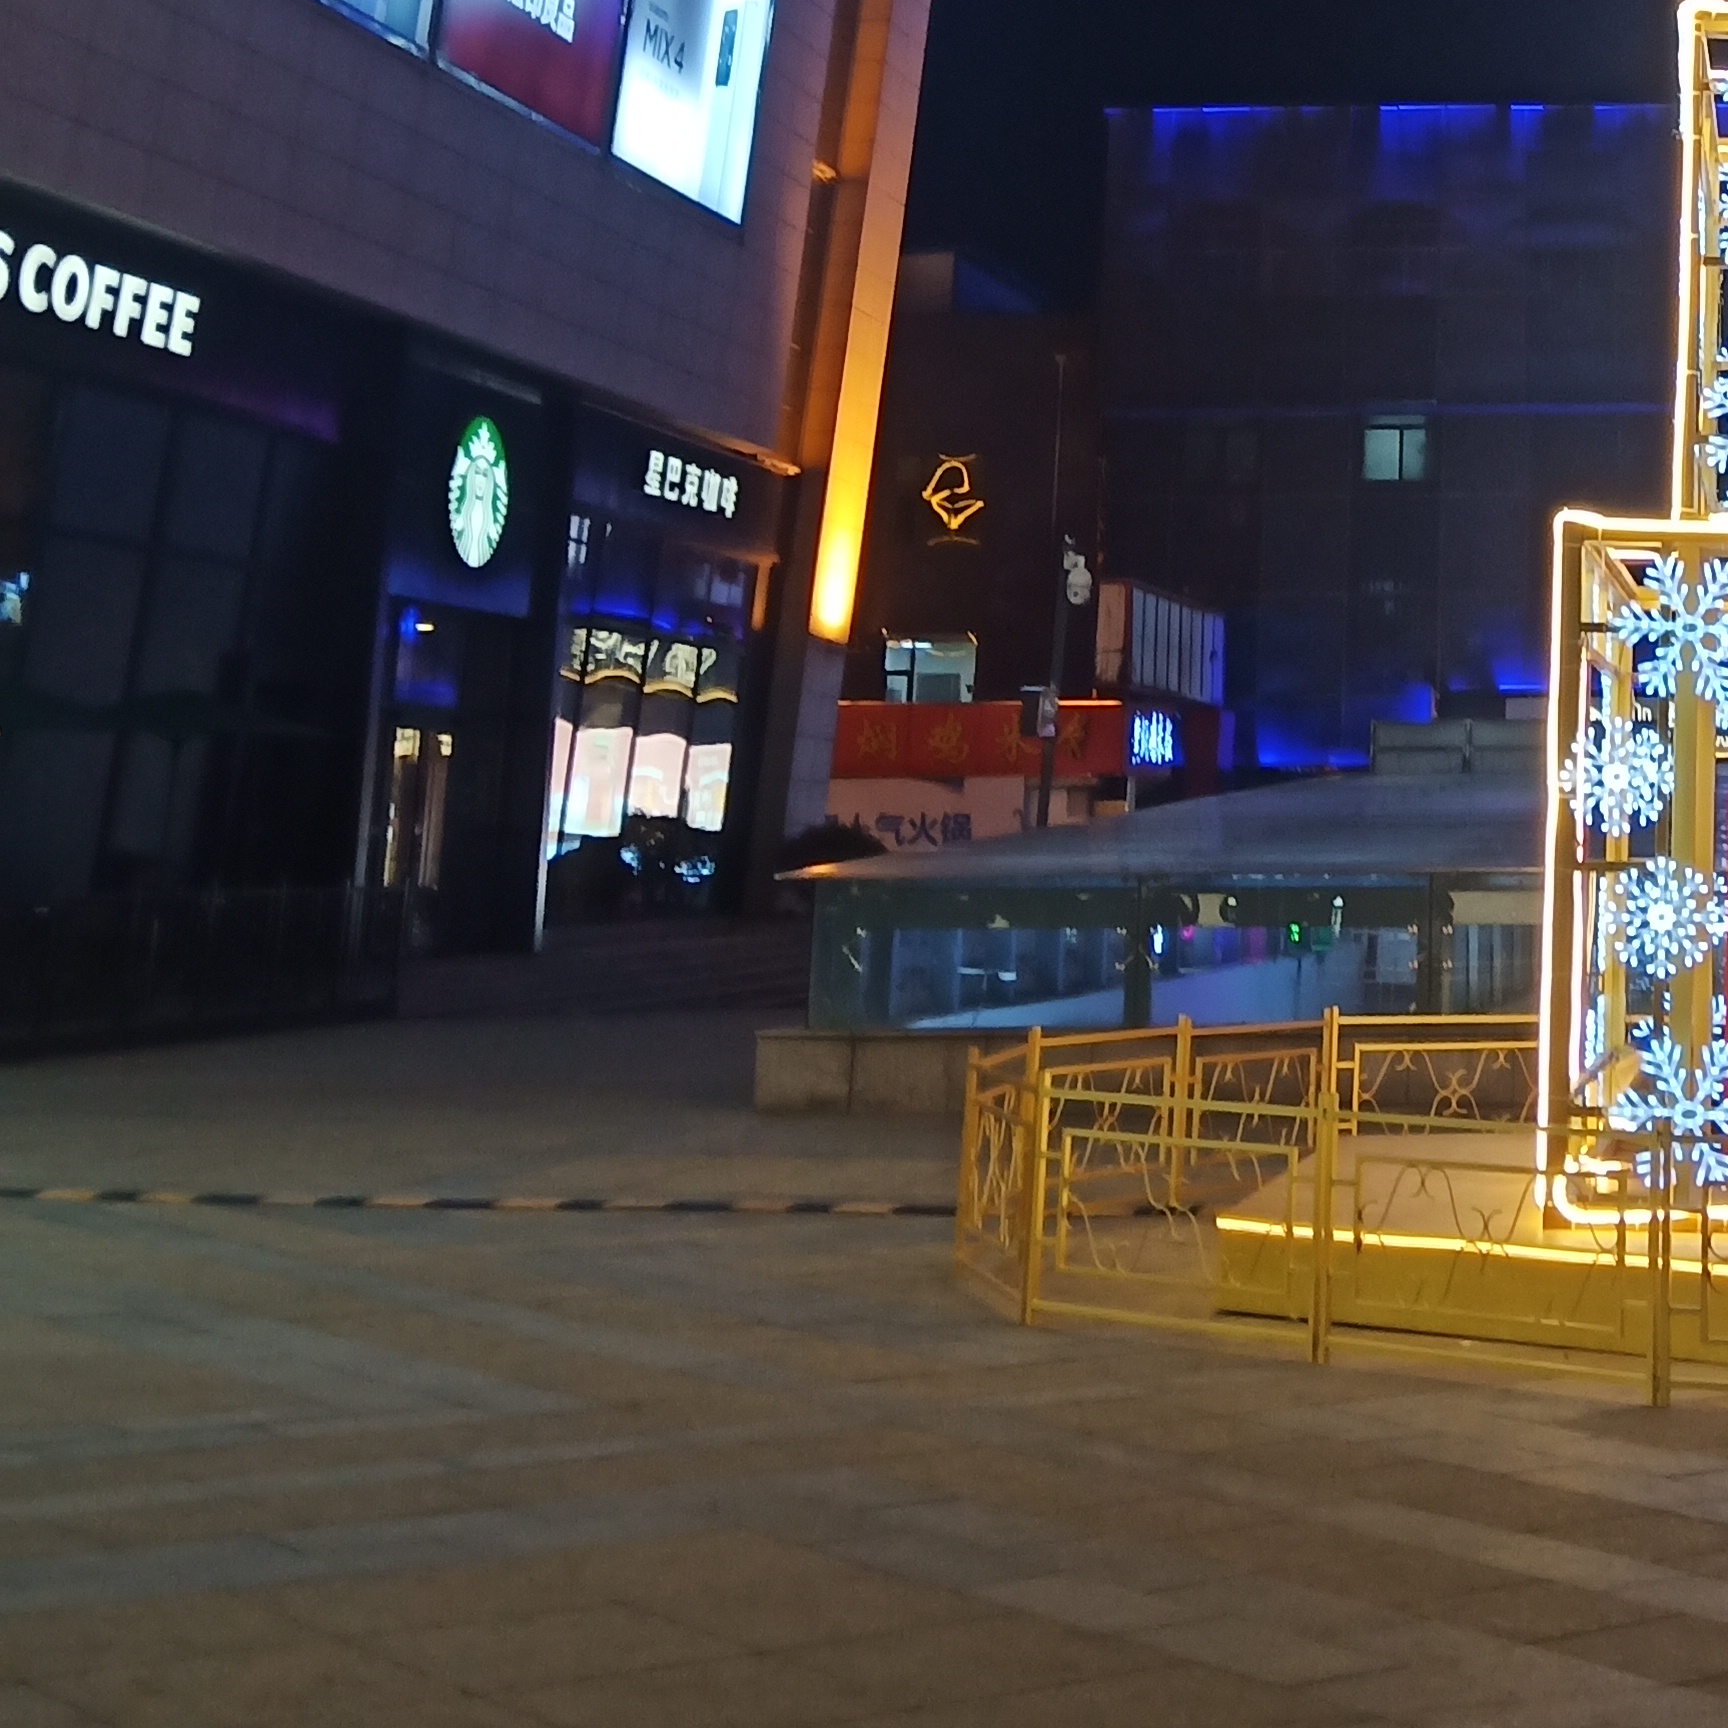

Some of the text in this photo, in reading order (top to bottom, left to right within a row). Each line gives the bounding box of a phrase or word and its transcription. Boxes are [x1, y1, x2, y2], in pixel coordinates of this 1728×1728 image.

[642, 17, 686, 75] MIX 4
[18, 243, 201, 357] COFFEE
[643, 449, 739, 519] 星巴克咖啡
